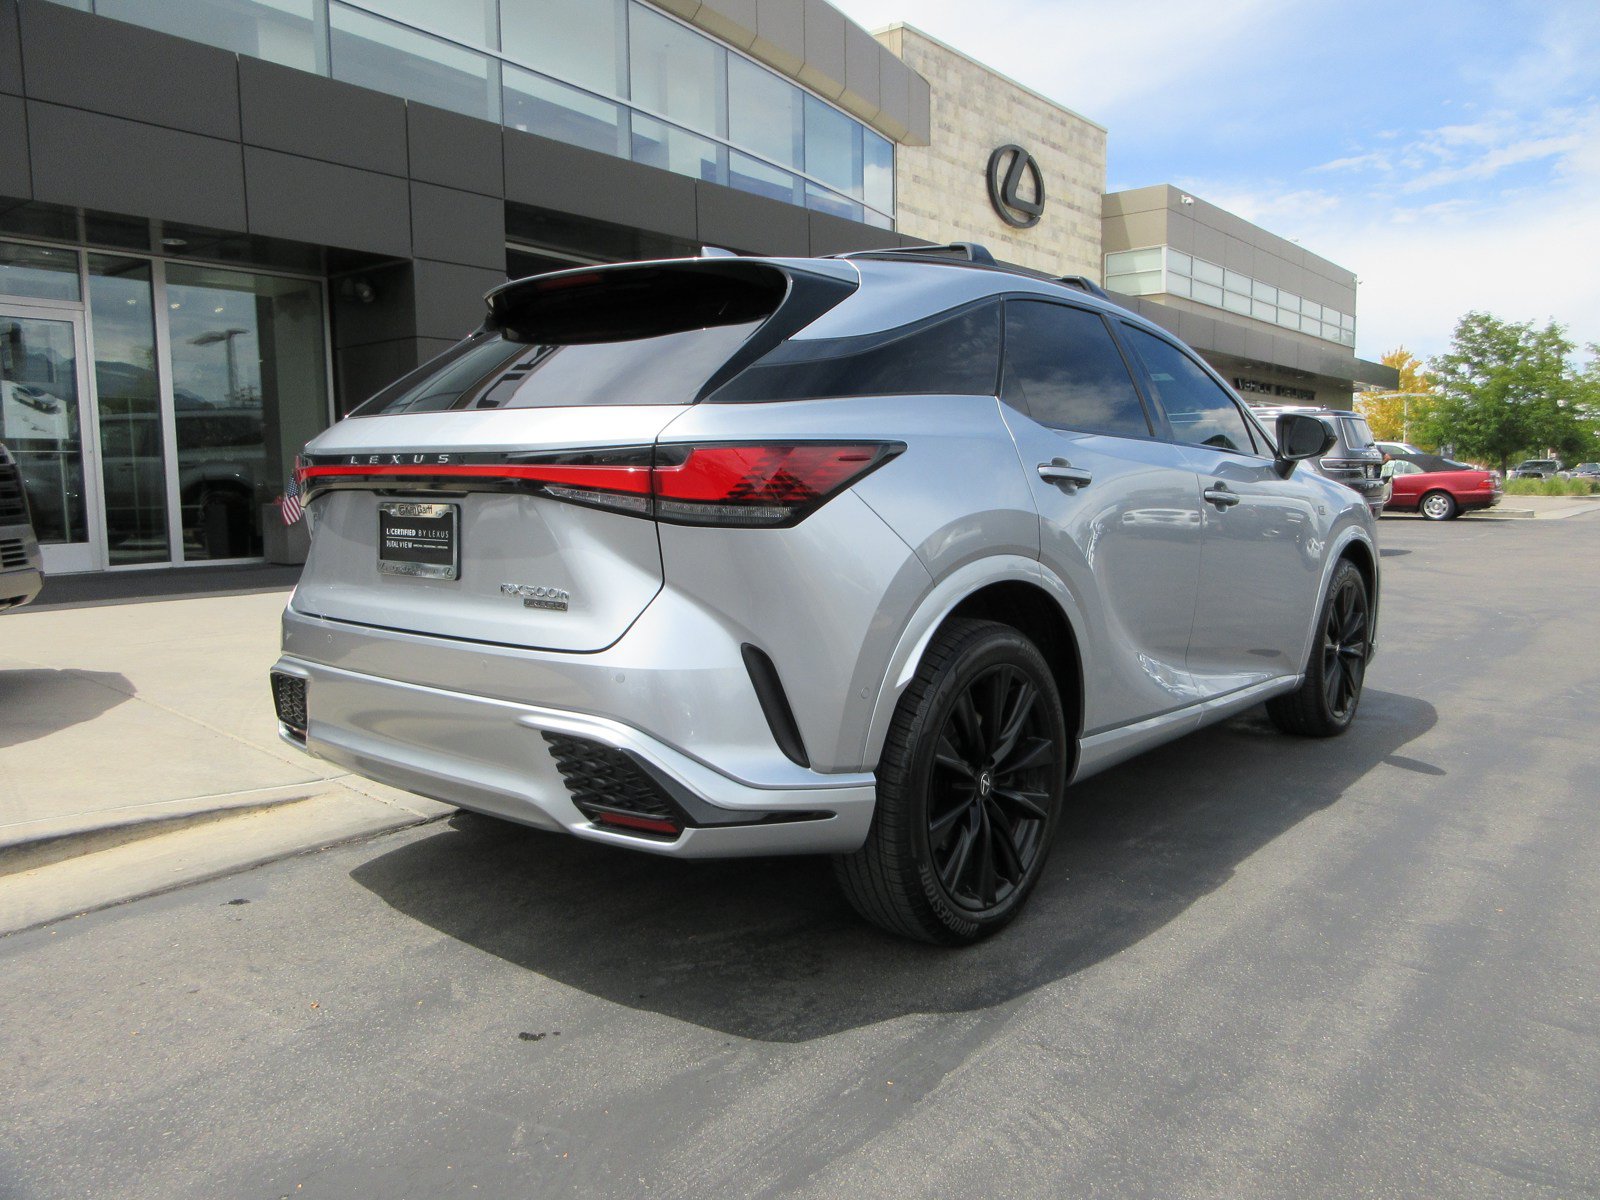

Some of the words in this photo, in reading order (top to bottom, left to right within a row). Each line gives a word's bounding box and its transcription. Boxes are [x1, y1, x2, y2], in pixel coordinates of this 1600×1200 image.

[350, 454, 450, 464] LEXUS
[428, 530, 449, 539] LEXUS
[399, 541, 413, 549] VIEW
[919, 862, 979, 937] BRIDGESTONE
